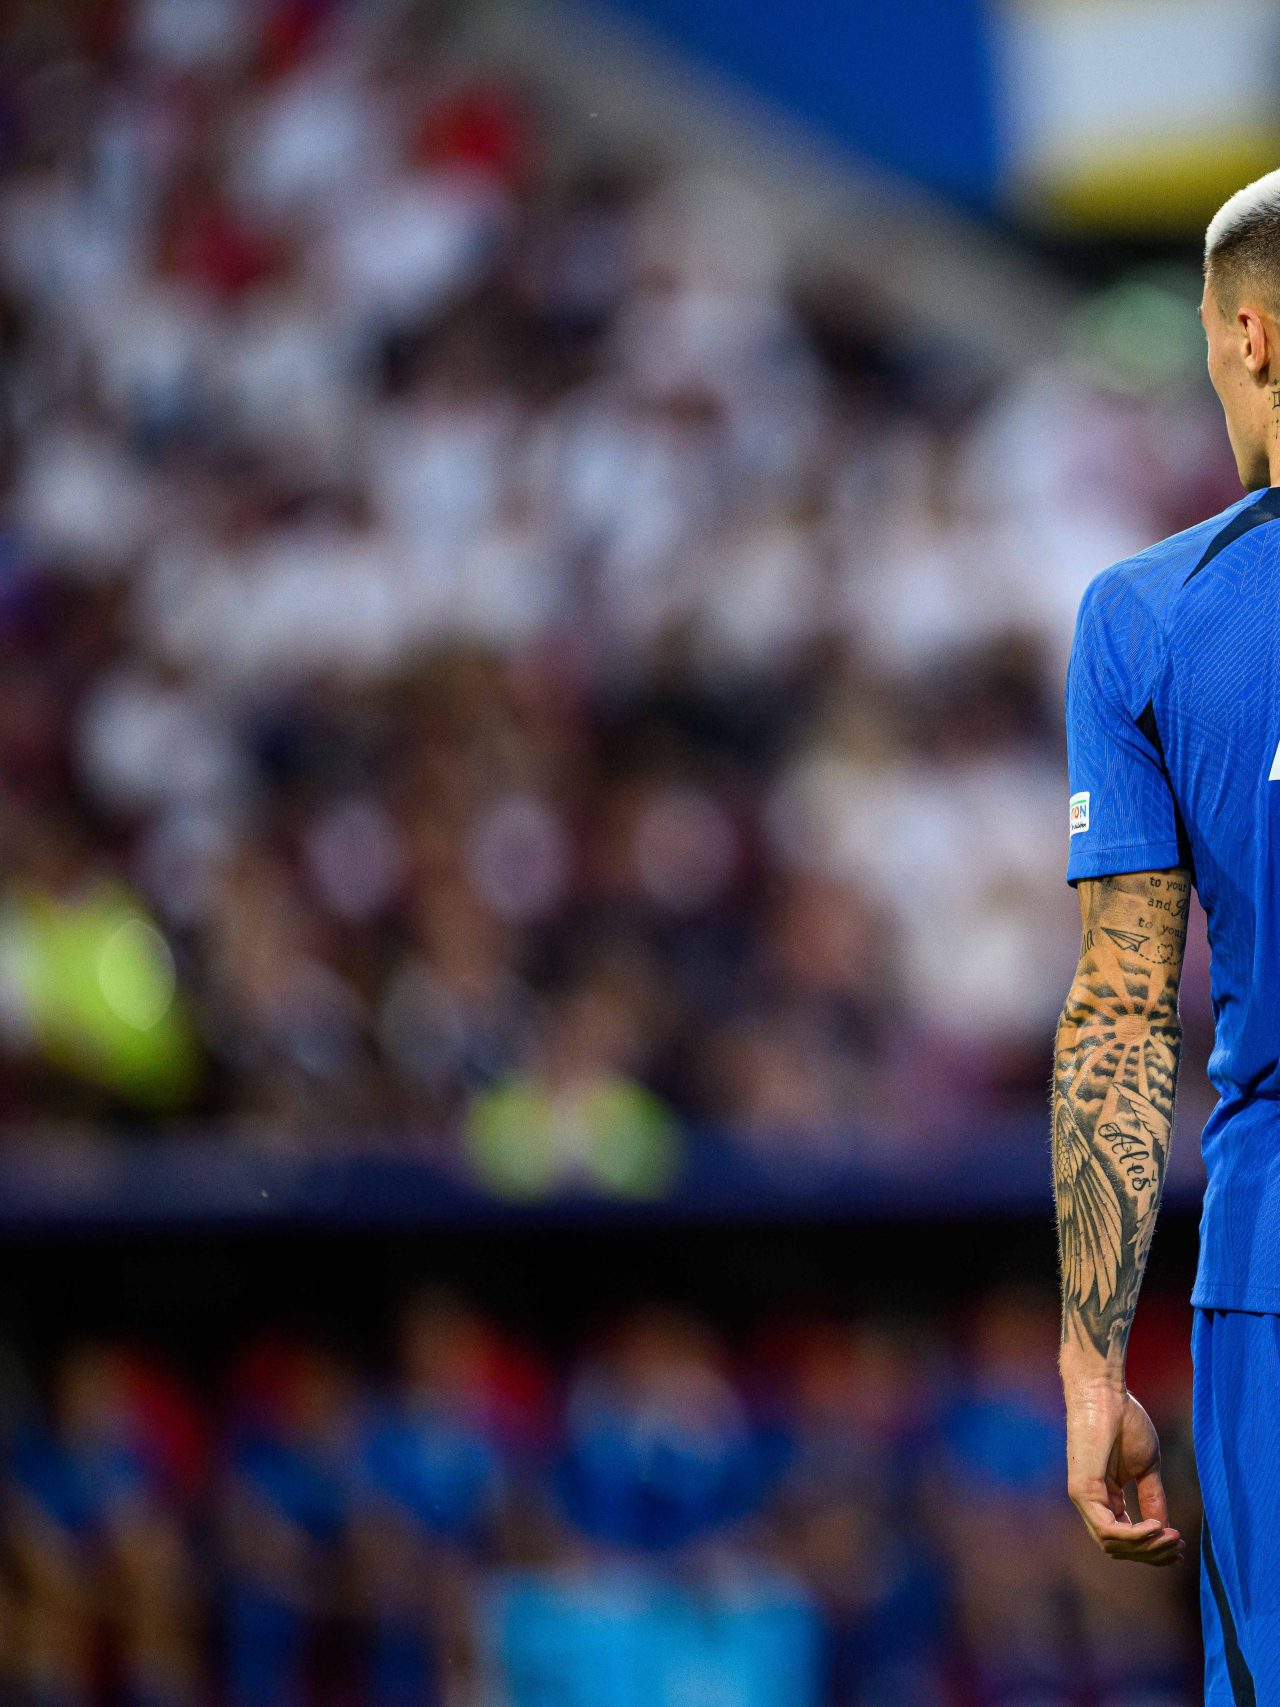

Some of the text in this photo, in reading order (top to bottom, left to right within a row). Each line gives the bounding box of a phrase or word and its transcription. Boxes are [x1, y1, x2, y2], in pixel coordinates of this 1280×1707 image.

[1149, 876, 1162, 888] to
[1147, 898, 1172, 911] and
[1137, 916, 1154, 930] to
